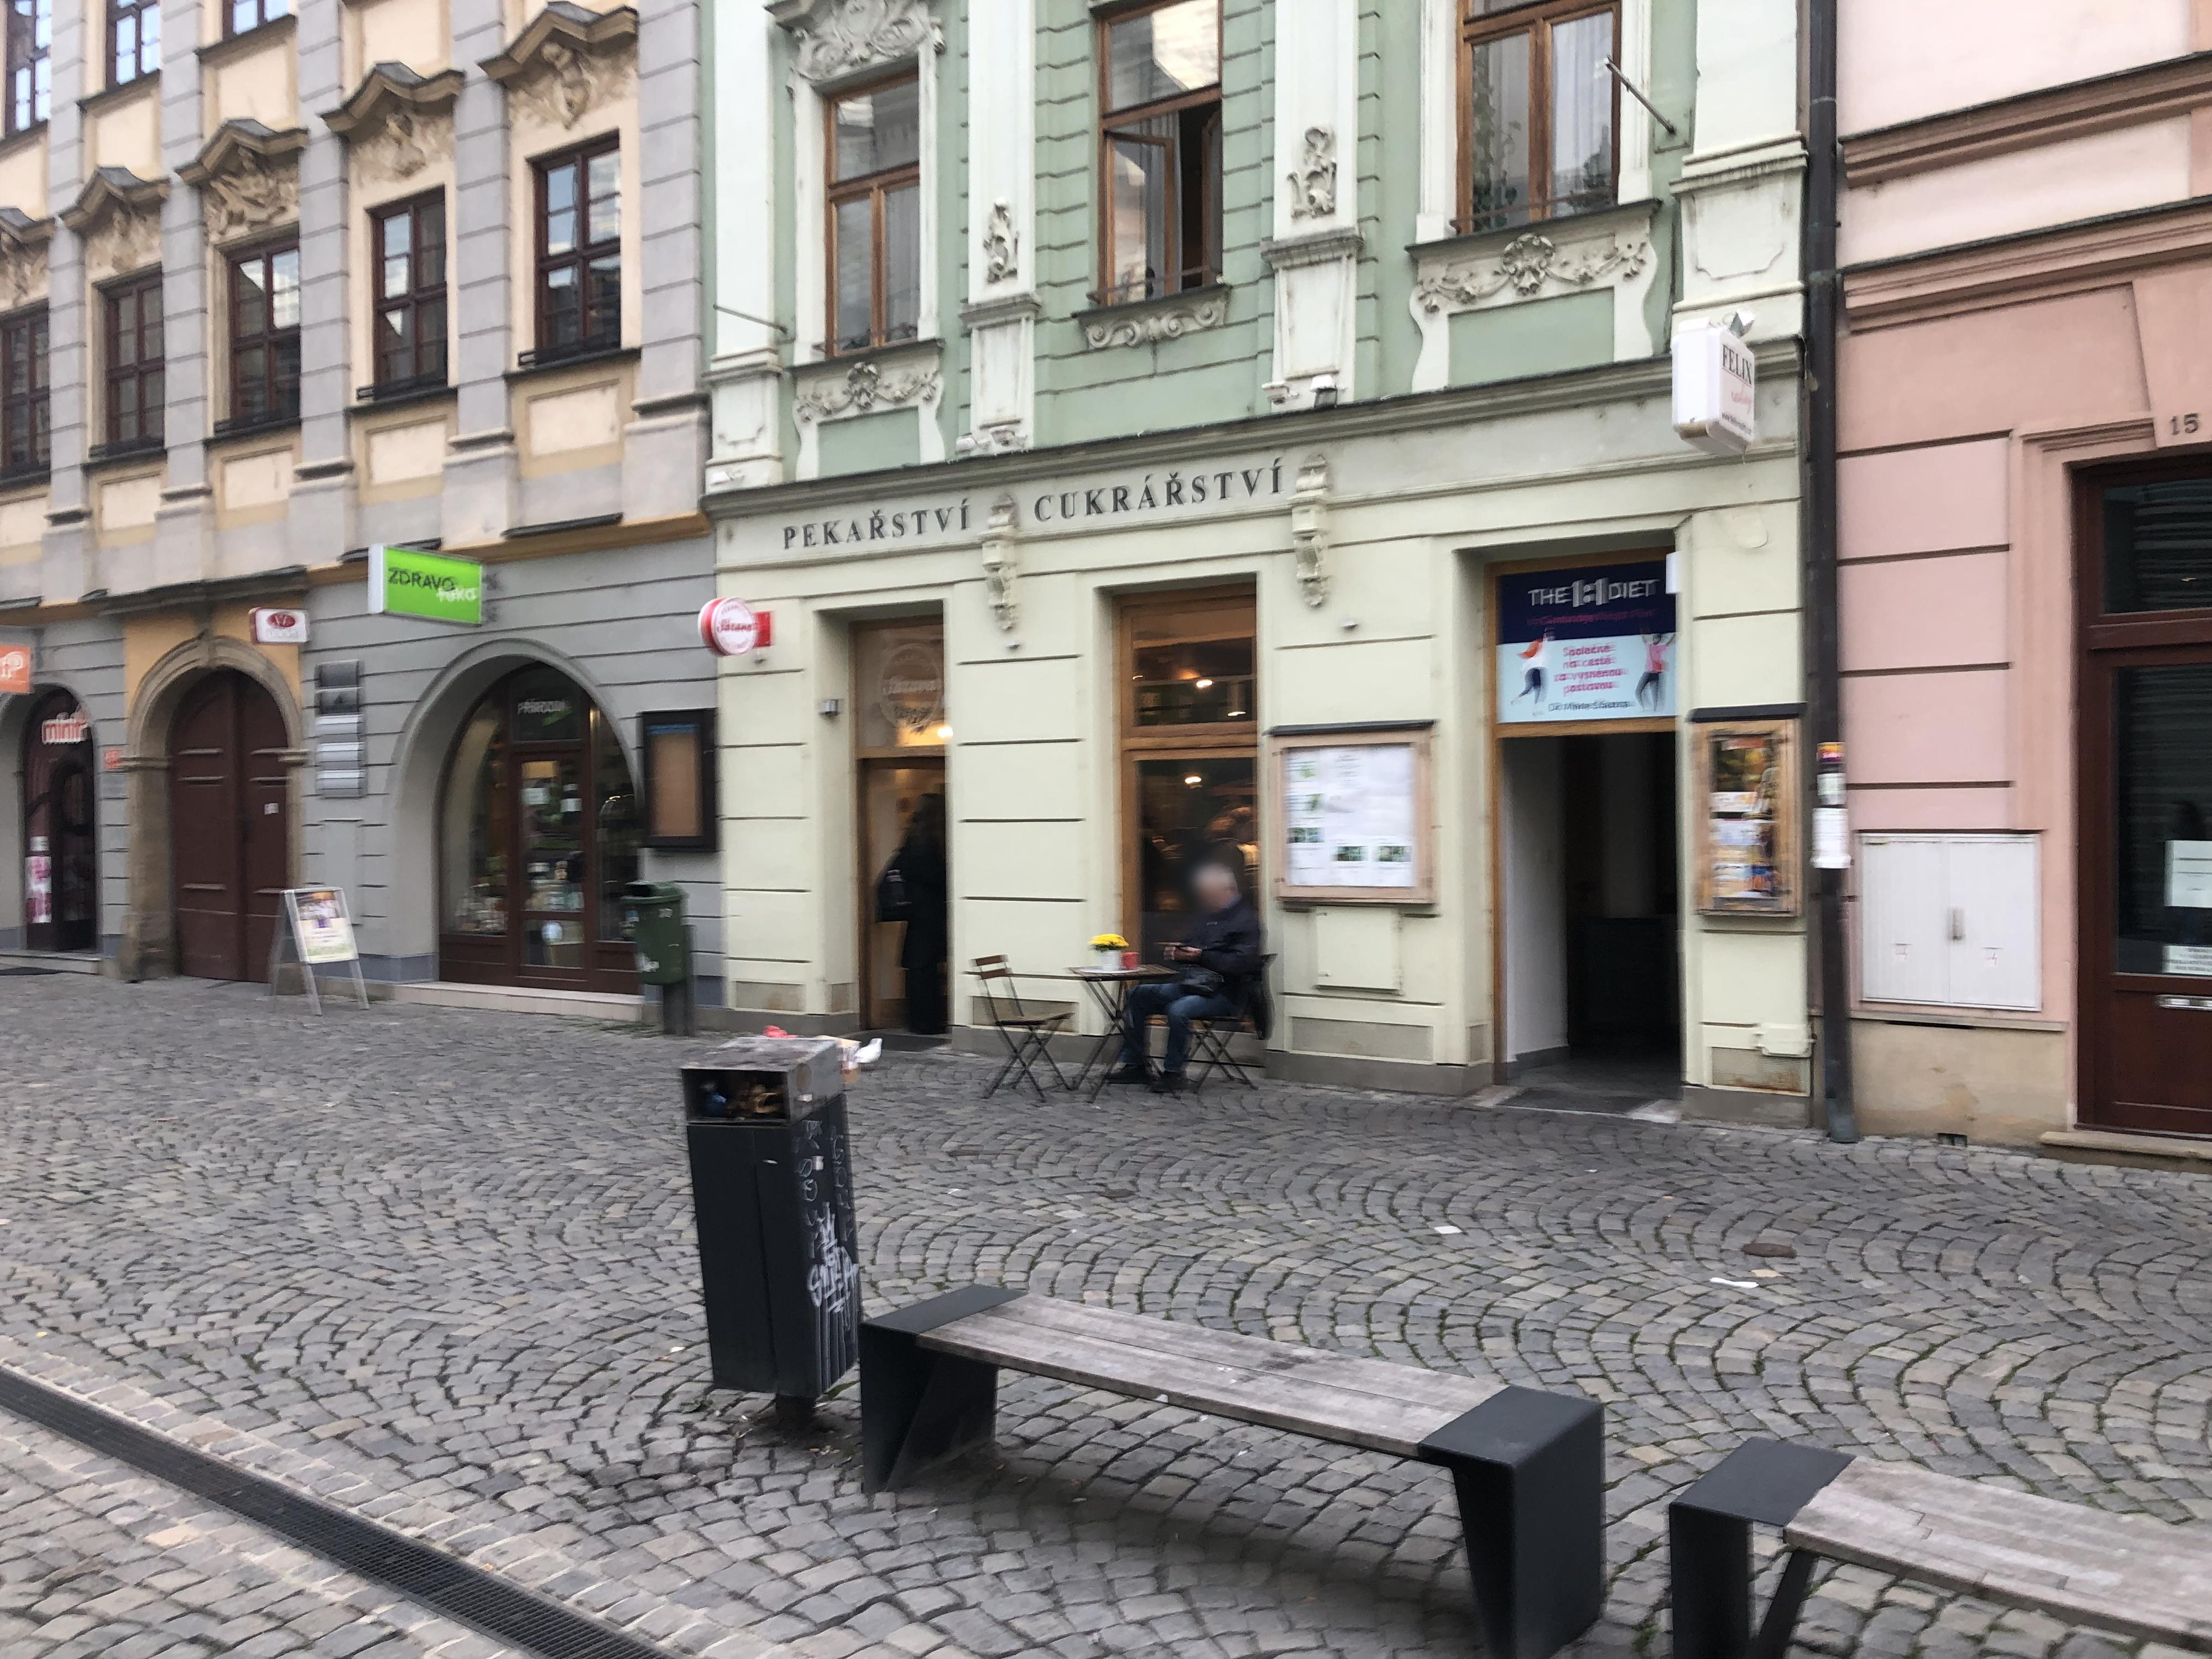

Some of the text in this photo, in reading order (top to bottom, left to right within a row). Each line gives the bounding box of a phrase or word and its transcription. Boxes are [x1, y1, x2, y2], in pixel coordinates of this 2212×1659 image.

[1723, 343, 1752, 385] FELIX
[2169, 413, 2199, 435] 15
[782, 456, 1283, 550] PEKAŘSTVÍ CUKRÁŘSTVÍ
[388, 566, 456, 592] ZDRAVO
[1528, 586, 1573, 606] THE
[1609, 579, 1659, 600] DIET
